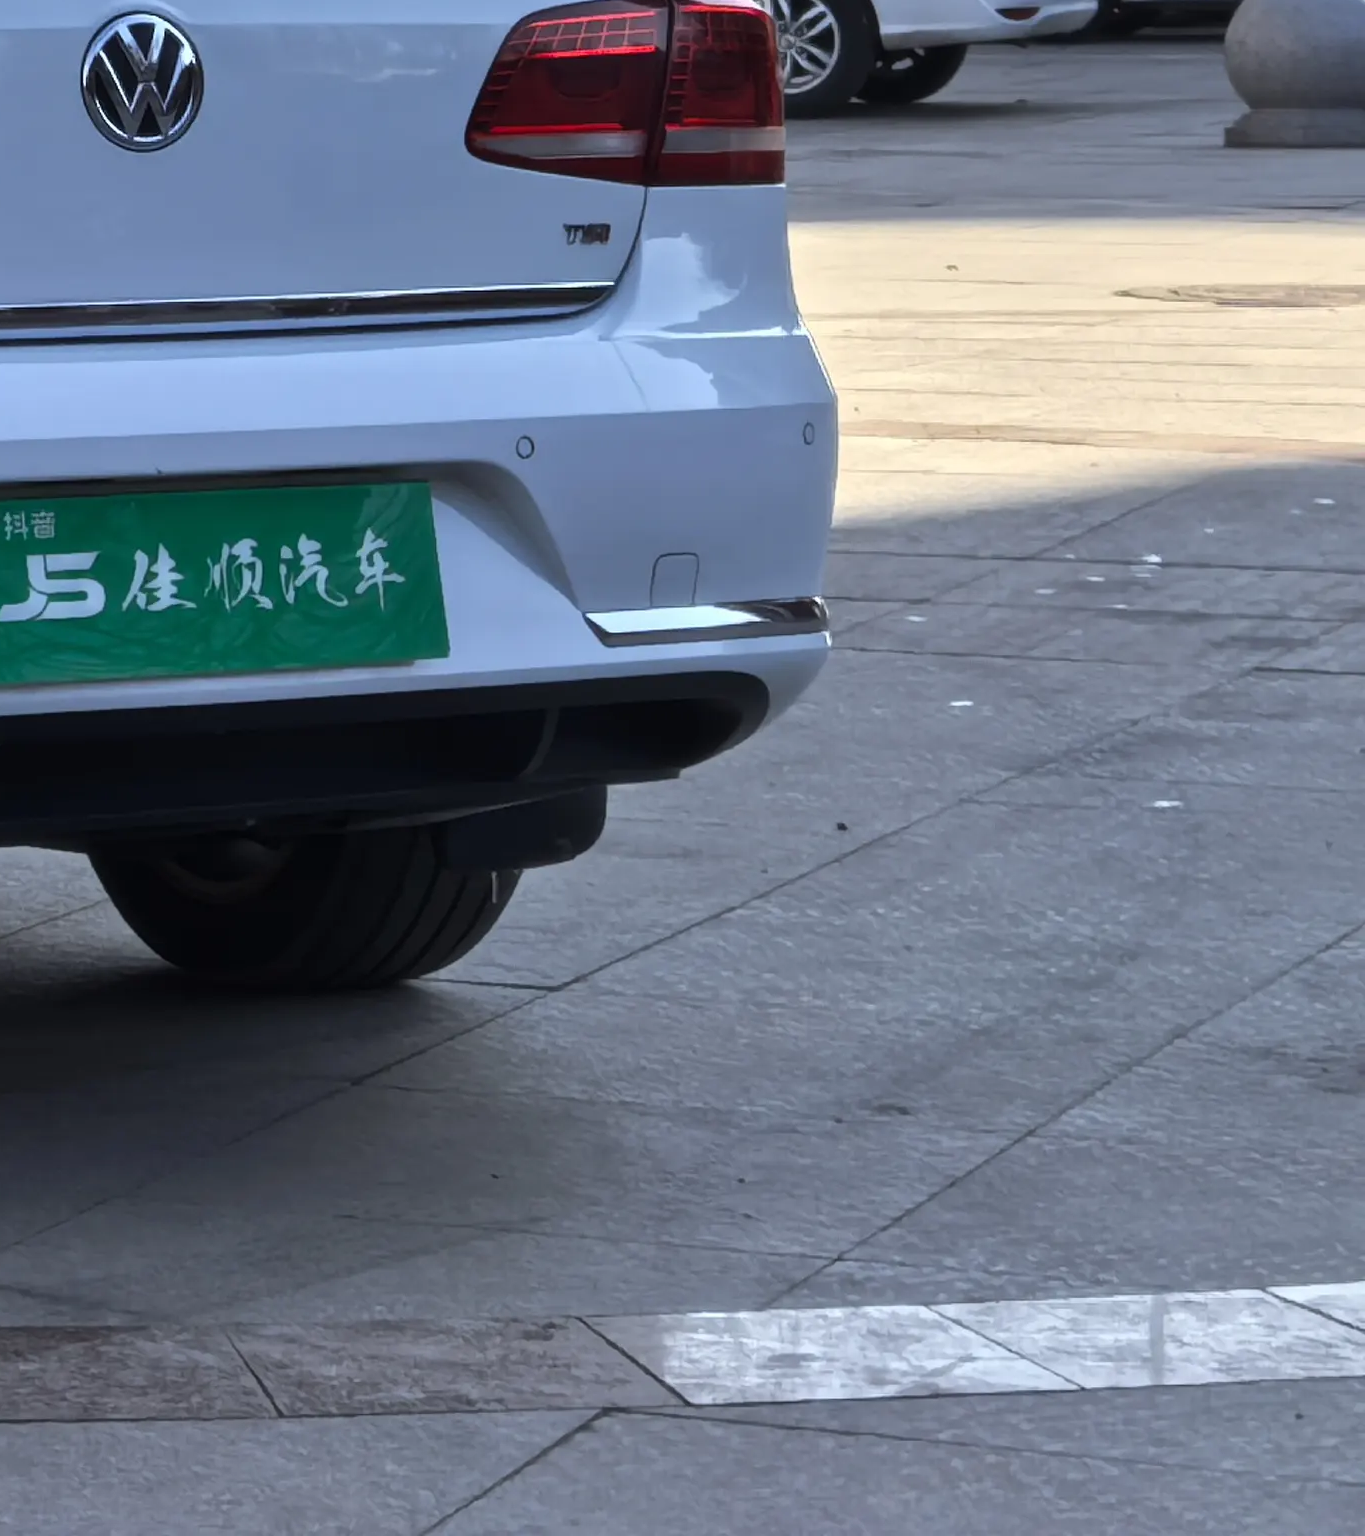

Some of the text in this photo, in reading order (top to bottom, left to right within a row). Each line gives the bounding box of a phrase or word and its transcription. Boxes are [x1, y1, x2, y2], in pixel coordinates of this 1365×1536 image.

[3, 509, 56, 540] 抖音
[122, 527, 406, 615] 佳顺汽车
